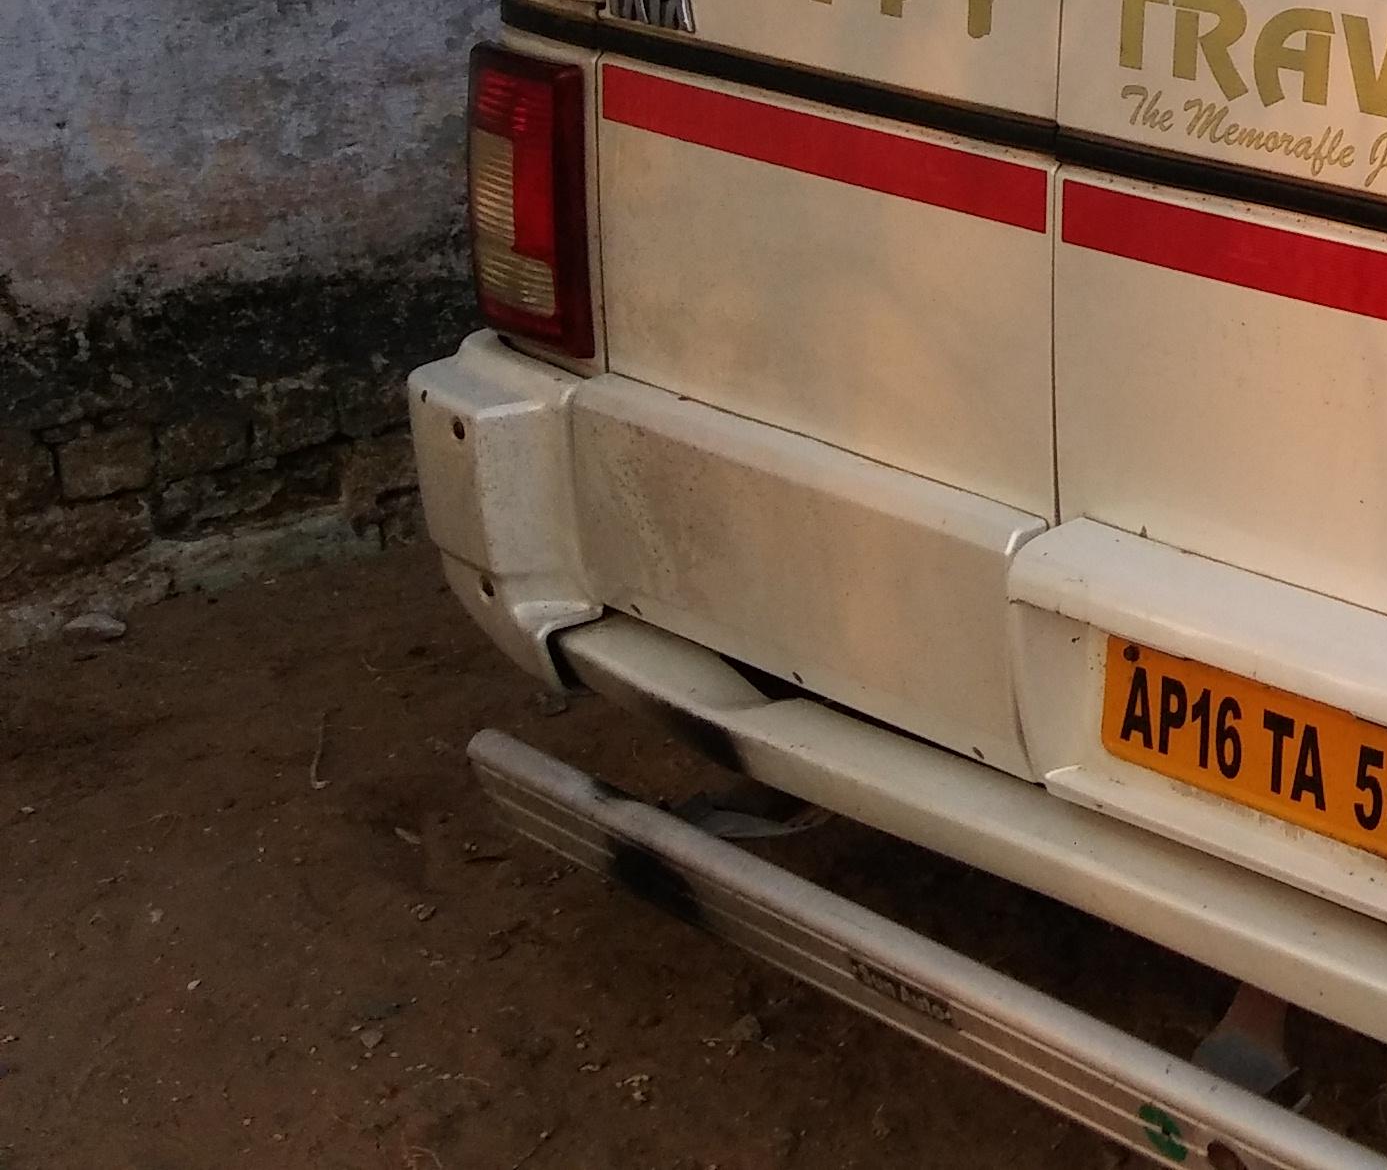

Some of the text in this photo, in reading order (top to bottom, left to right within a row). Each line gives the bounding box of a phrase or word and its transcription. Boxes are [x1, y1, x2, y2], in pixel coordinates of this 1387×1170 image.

[1121, 84, 1174, 134] The
[1120, 666, 1242, 779] AP16
[1263, 709, 1326, 811] TA
